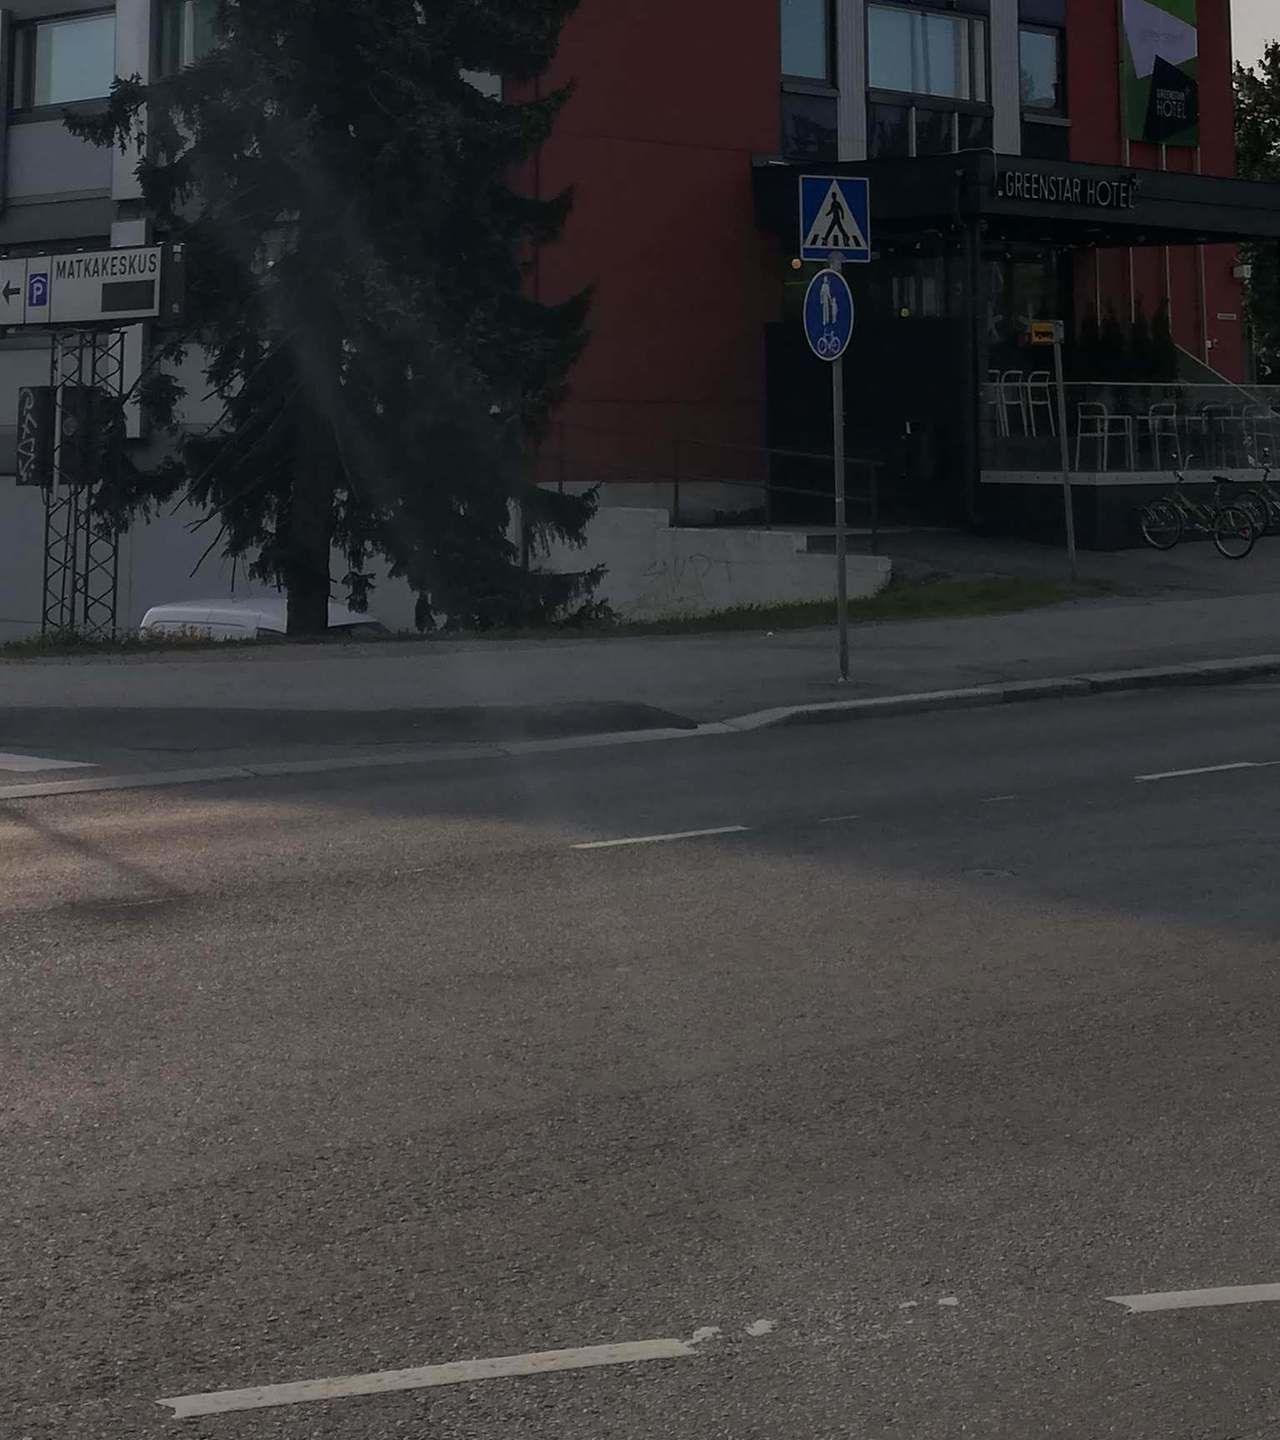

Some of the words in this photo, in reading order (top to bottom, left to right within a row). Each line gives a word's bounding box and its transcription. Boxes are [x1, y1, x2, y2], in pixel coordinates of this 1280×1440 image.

[1156, 100, 1187, 119] HOTEL
[1006, 171, 1081, 204] GREENSTAR
[1087, 180, 1135, 208] HOTEL
[55, 254, 157, 280] MATKAKESKUS
[32, 282, 44, 305] P
